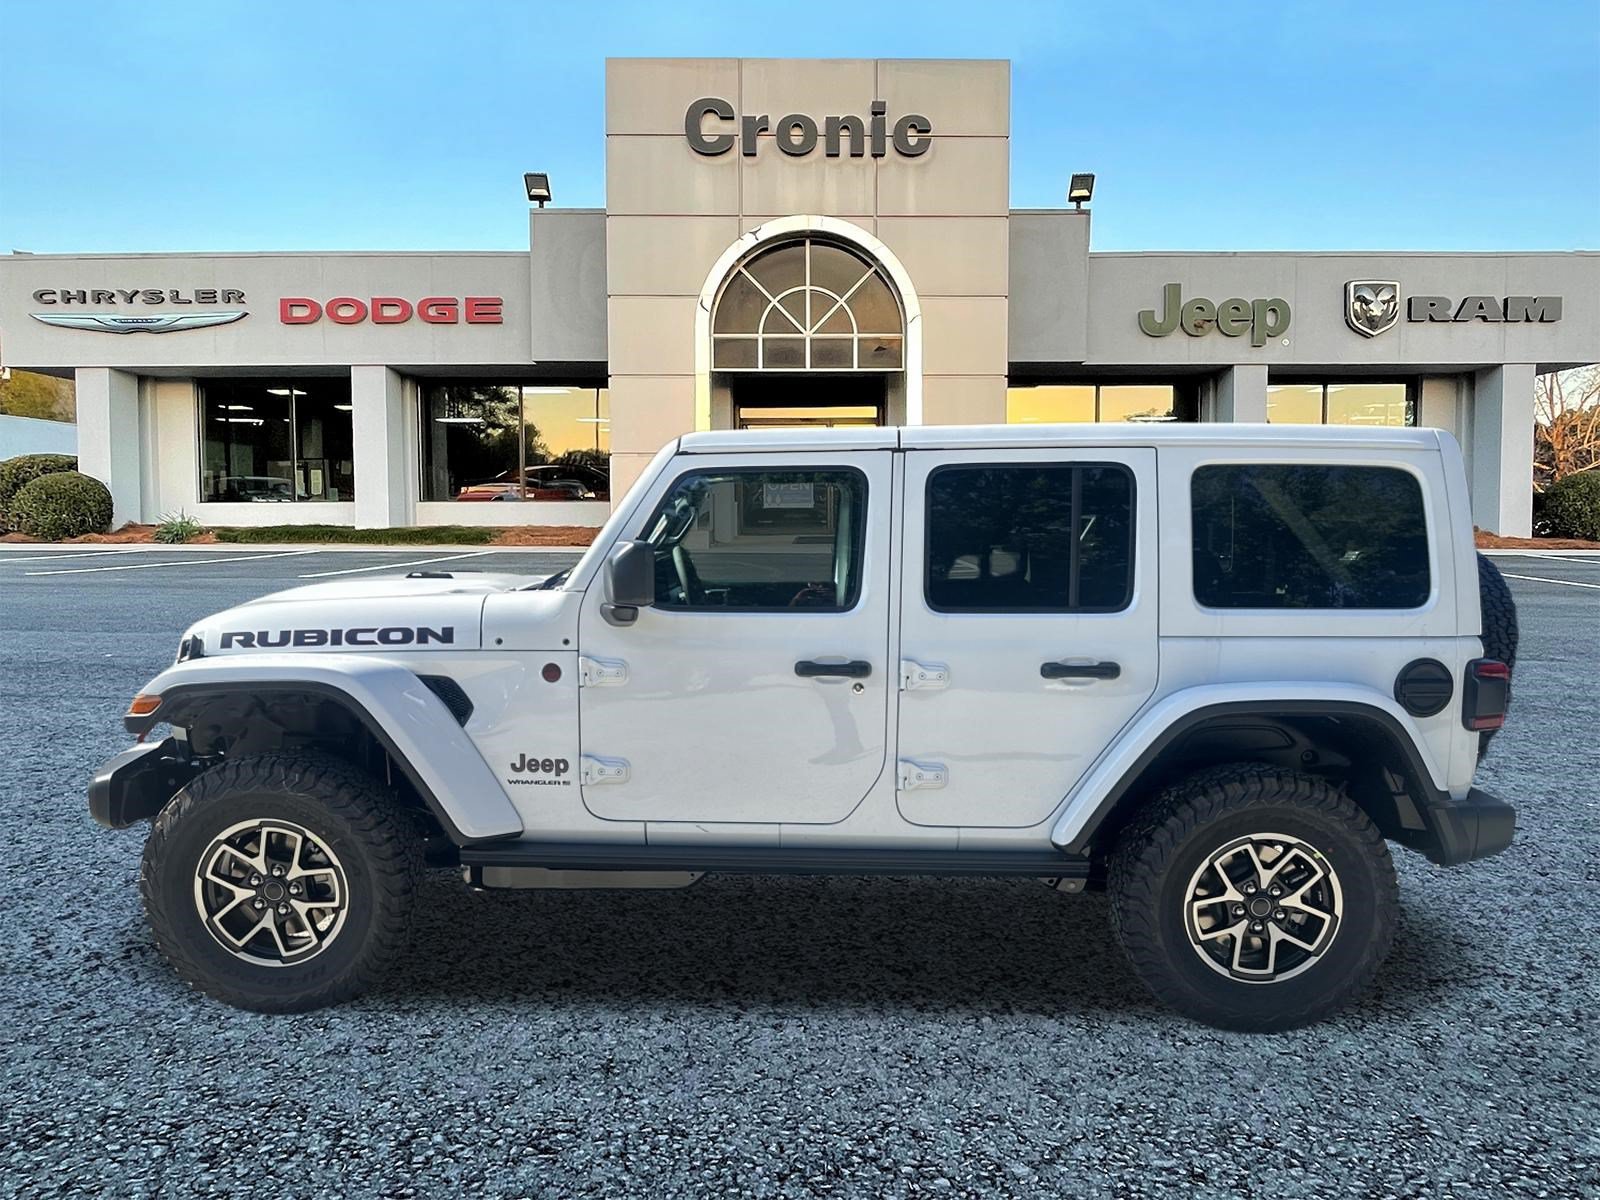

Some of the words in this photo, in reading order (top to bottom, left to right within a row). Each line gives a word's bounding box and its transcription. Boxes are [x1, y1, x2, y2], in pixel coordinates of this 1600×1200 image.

[684, 97, 932, 158] Cronic
[32, 288, 246, 305] CHRYSLER
[1407, 296, 1562, 322] RAM
[280, 297, 504, 325] DODGE
[1138, 283, 1291, 347] Jeep
[220, 627, 454, 649] RUBICON
[510, 753, 569, 776] Jeep
